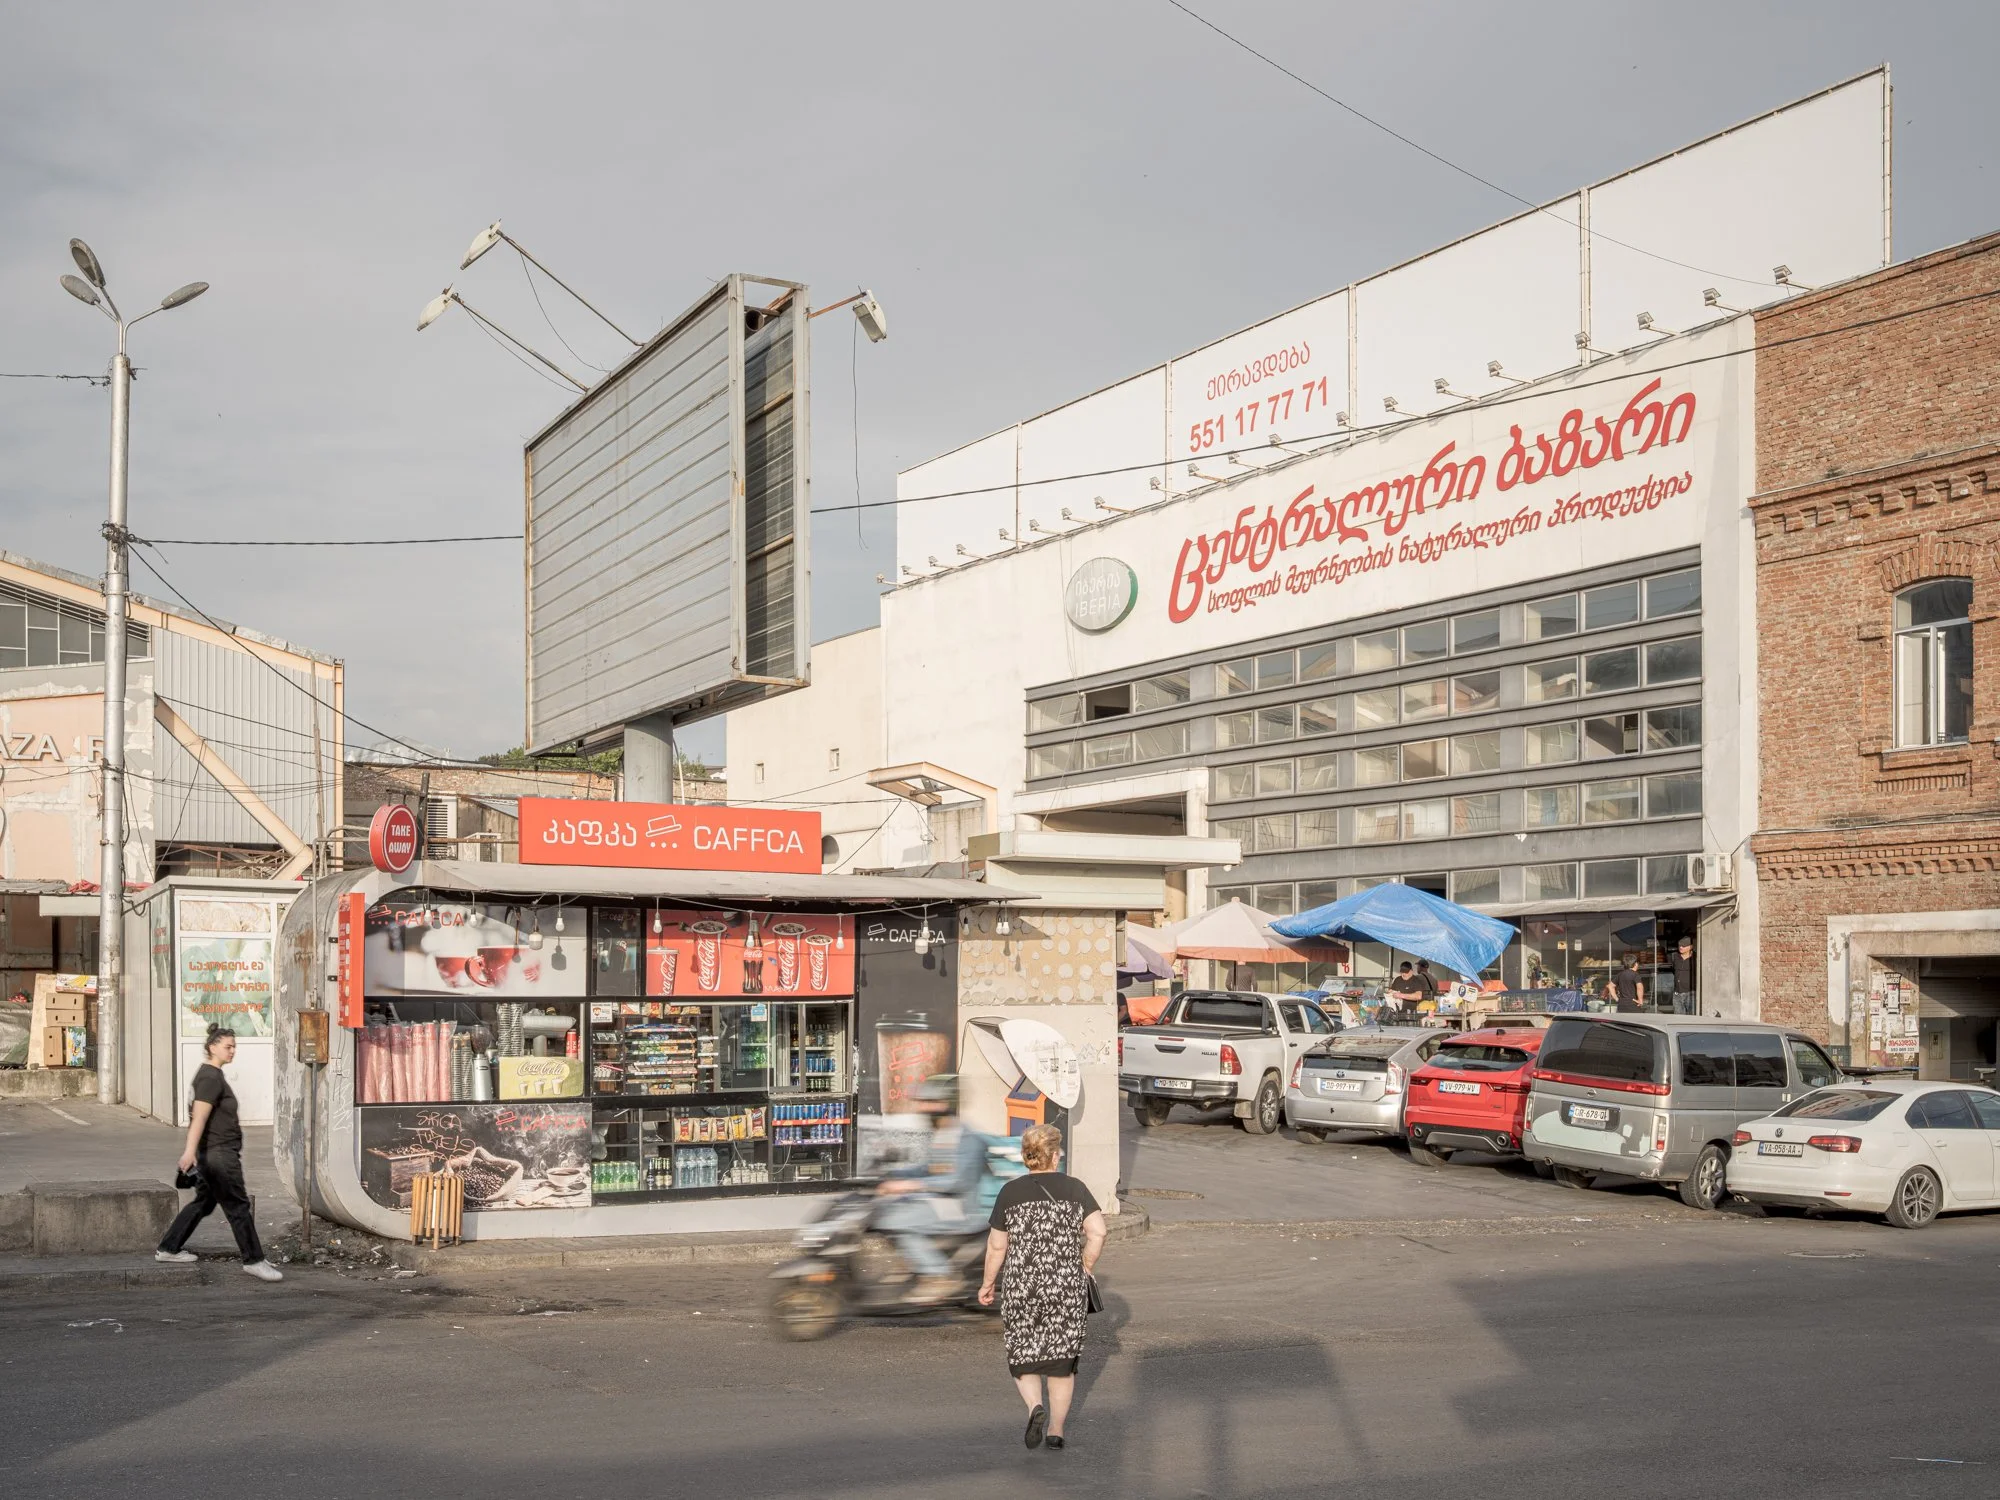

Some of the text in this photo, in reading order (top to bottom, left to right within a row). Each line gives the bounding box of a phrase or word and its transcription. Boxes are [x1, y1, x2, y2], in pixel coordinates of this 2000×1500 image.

[1207, 341, 1310, 400] ქირავდება
[1190, 376, 1327, 452] 551 17 77 71
[1168, 377, 1696, 624] ცენტრალური ბაზარი
[1208, 471, 1693, 613] სოფლის მეურნეობის ნატურალური პროდუქცია
[1075, 593, 1120, 618] IBERIA
[391, 825, 411, 837] TAKE
[543, 819, 637, 846] კაფკა
[693, 826, 804, 853] CAFFCA
[389, 842, 411, 854] AWAY
[521, 1115, 587, 1131] CAFFCA
